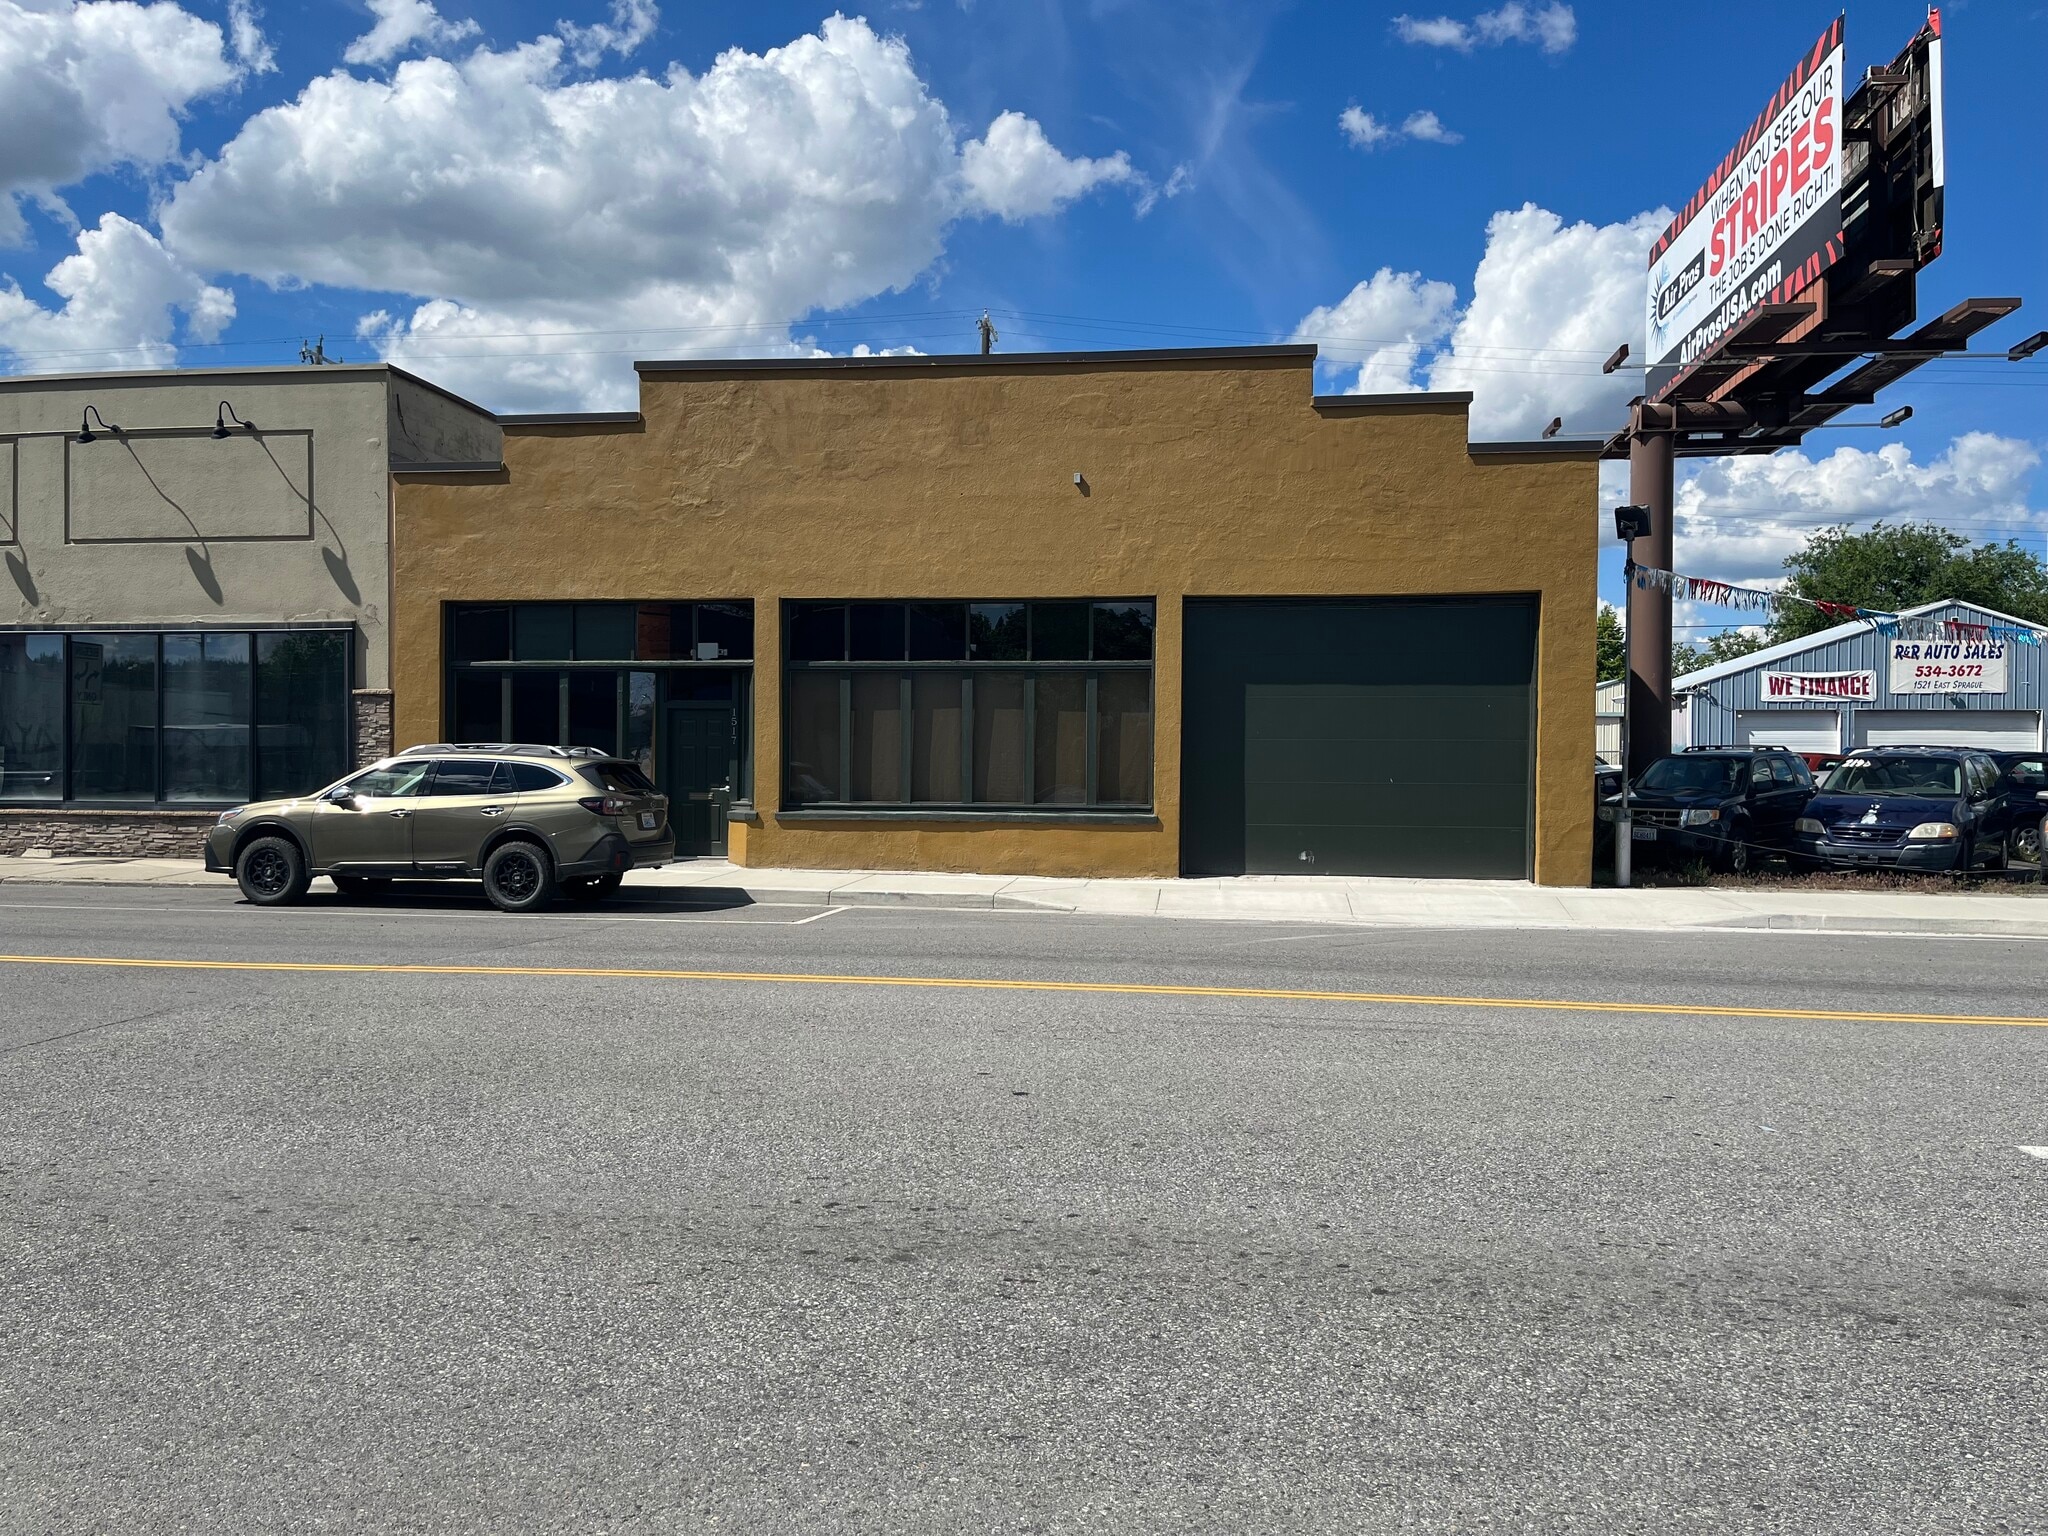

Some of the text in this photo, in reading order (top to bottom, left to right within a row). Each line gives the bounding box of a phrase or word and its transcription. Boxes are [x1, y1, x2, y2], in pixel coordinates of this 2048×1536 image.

[1711, 64, 1833, 224] WHEN YOU SEE OUR
[1709, 96, 1834, 277] STRIPES
[1709, 162, 1834, 304] THE JOB'S DONE RIGHT!
[1662, 284, 1679, 315] Air
[1678, 261, 1701, 299] Pros
[1679, 259, 1782, 370] AirProsUSA.com
[1895, 644, 2004, 660] R&R AUTO SALES
[1915, 665, 1982, 677] 534-3672
[1768, 675, 1870, 696] WE FINANCE
[1913, 680, 1983, 689] 1521 EAST SPRAGUE
